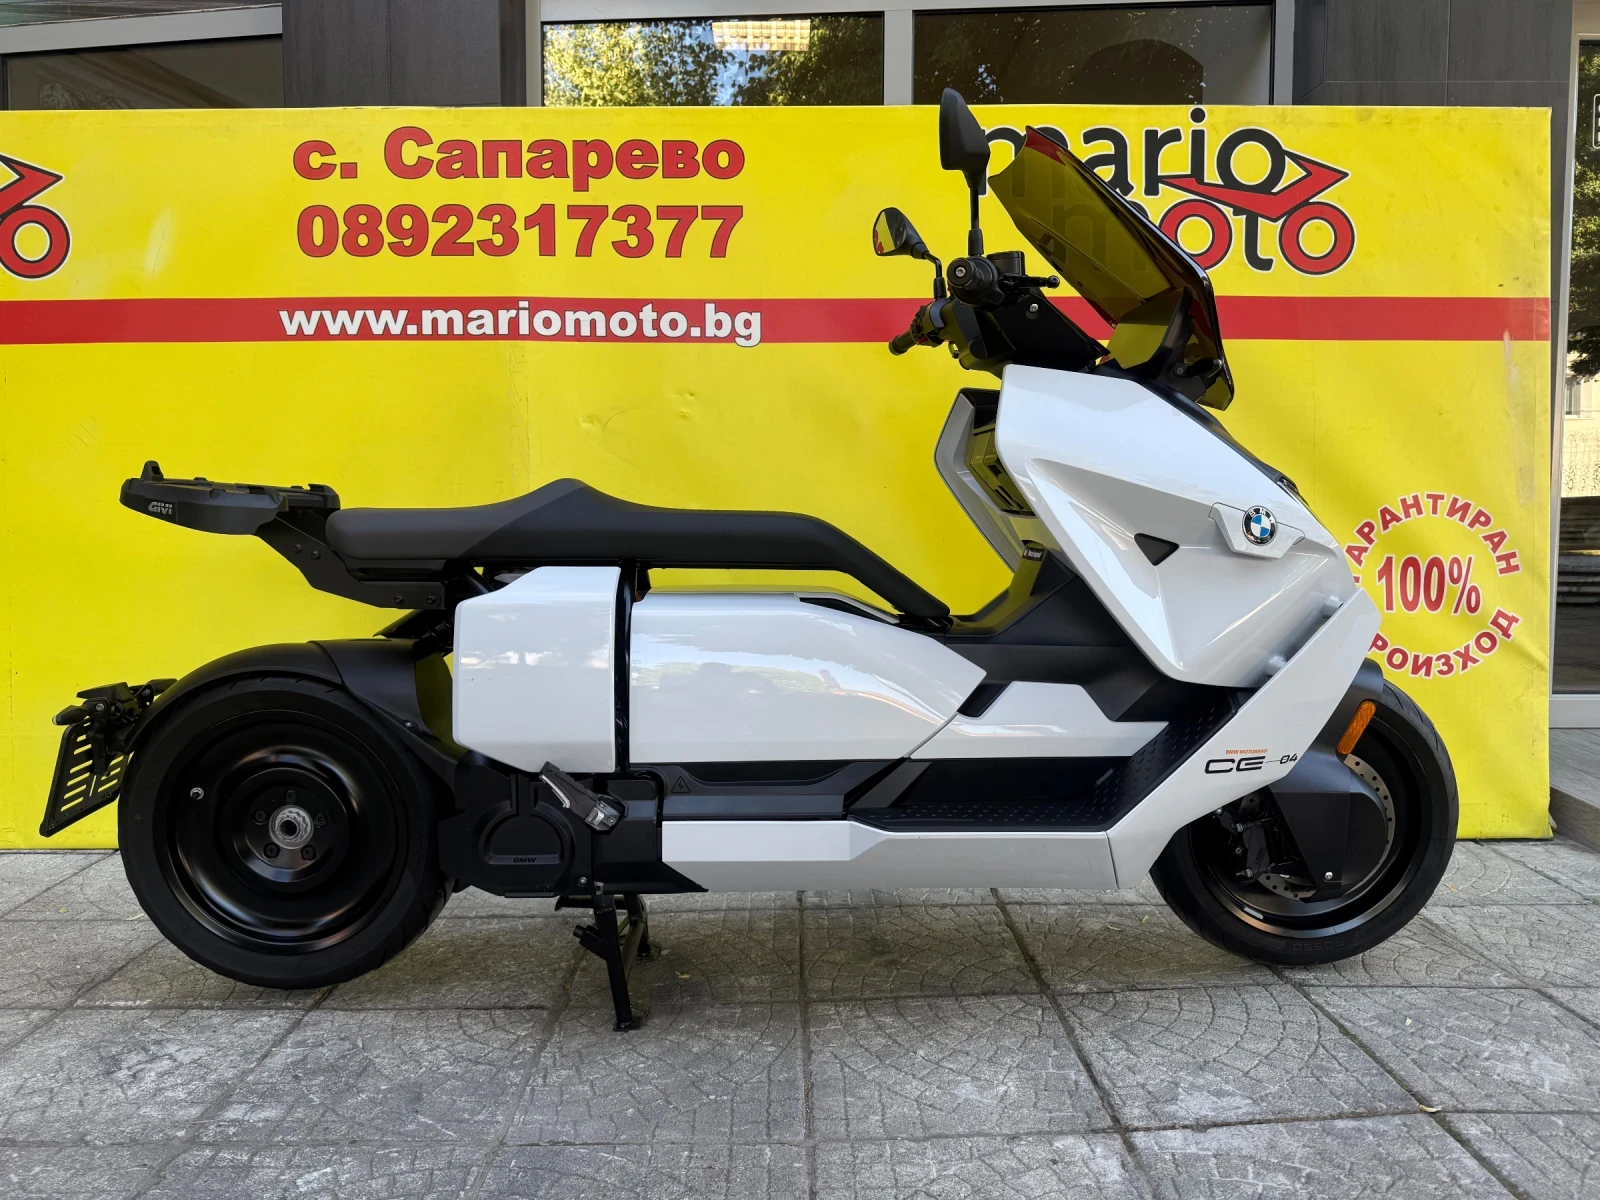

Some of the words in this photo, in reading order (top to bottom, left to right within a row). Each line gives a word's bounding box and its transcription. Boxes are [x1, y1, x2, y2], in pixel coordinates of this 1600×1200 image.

[293, 139, 358, 180] с.
[383, 126, 746, 193] Сапарево
[296, 203, 744, 259] 0892317377
[278, 300, 763, 348] www.mariomoto.bg
[147, 501, 173, 515] GIVI
[1344, 492, 1521, 584] АРАНТИРАН
[1377, 556, 1481, 614] 100%
[1367, 608, 1520, 678] РОИЗХОД
